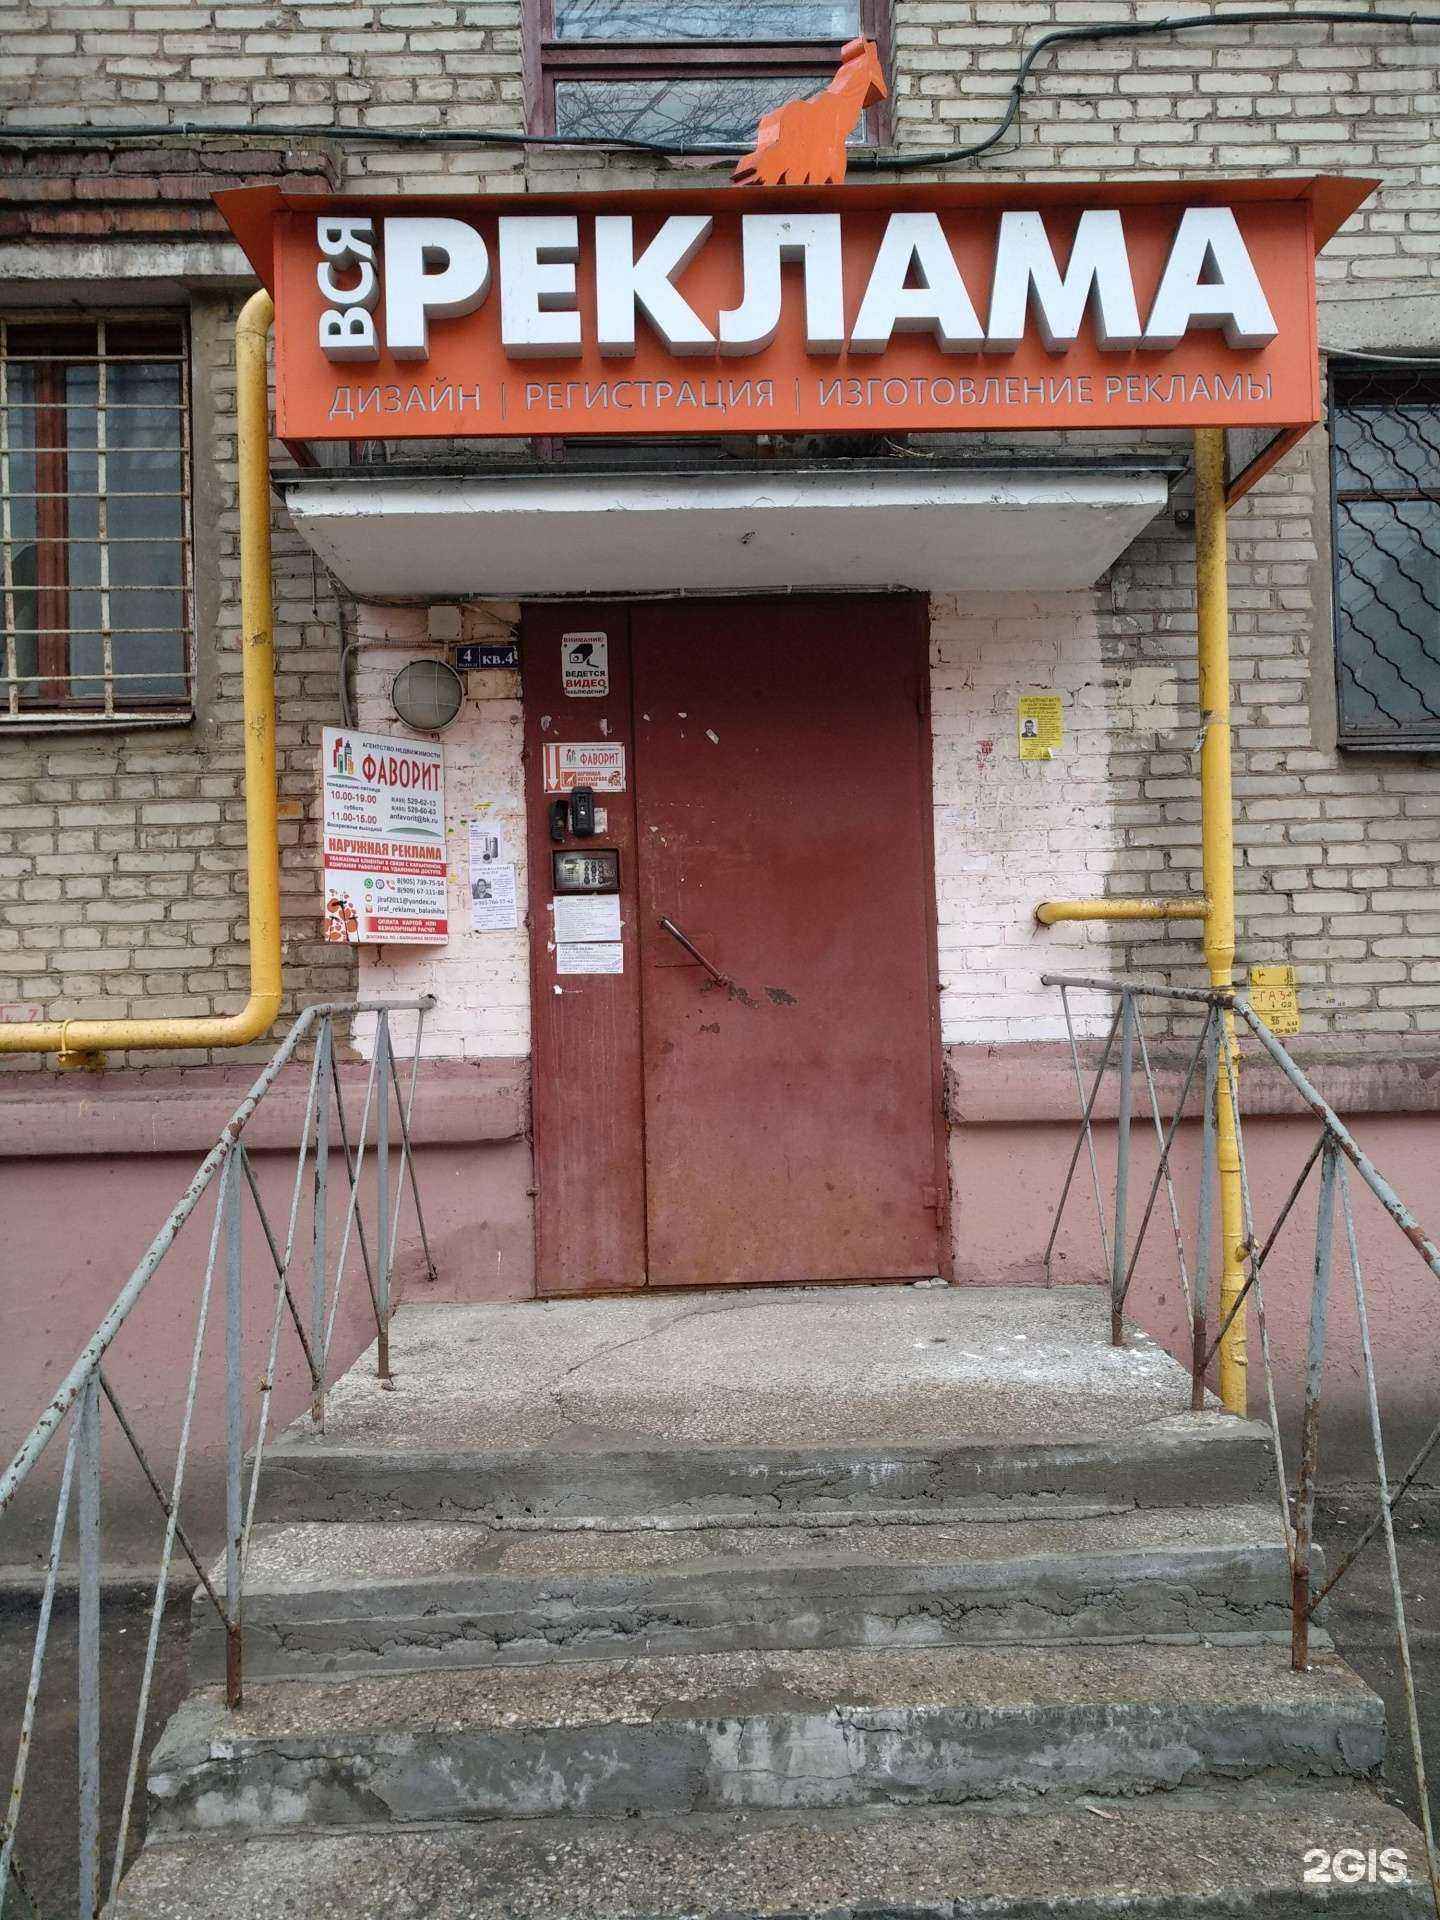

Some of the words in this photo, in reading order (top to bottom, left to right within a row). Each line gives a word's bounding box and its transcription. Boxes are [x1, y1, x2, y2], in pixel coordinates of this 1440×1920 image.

[317, 216, 380, 361] ВСЯ
[384, 207, 1279, 361] РЕКЛАМА
[328, 376, 481, 421] ДИЗАЙН
[525, 380, 774, 414] РЕГИСТРАЦИЯ
[818, 375, 1094, 407] ИЗГОТОВЛЕНИЕ
[1105, 373, 1273, 404] РЕКЛАМЫ
[463, 649, 473, 662] 4
[565, 679, 606, 688] ВИДЕО
[363, 742, 395, 752] АГЕНТСТВО
[395, 747, 441, 758] НЕДВИЖИМОСТИ
[580, 753, 619, 765] ФАВОРИТ
[362, 753, 441, 791] ФАВОРИТ
[331, 791, 377, 804] 10.00-19.00
[331, 811, 378, 824] 11.00-15.00
[328, 838, 389, 855] НАРУЖНАЯ
[392, 844, 442, 860] РЕКЛАМА
